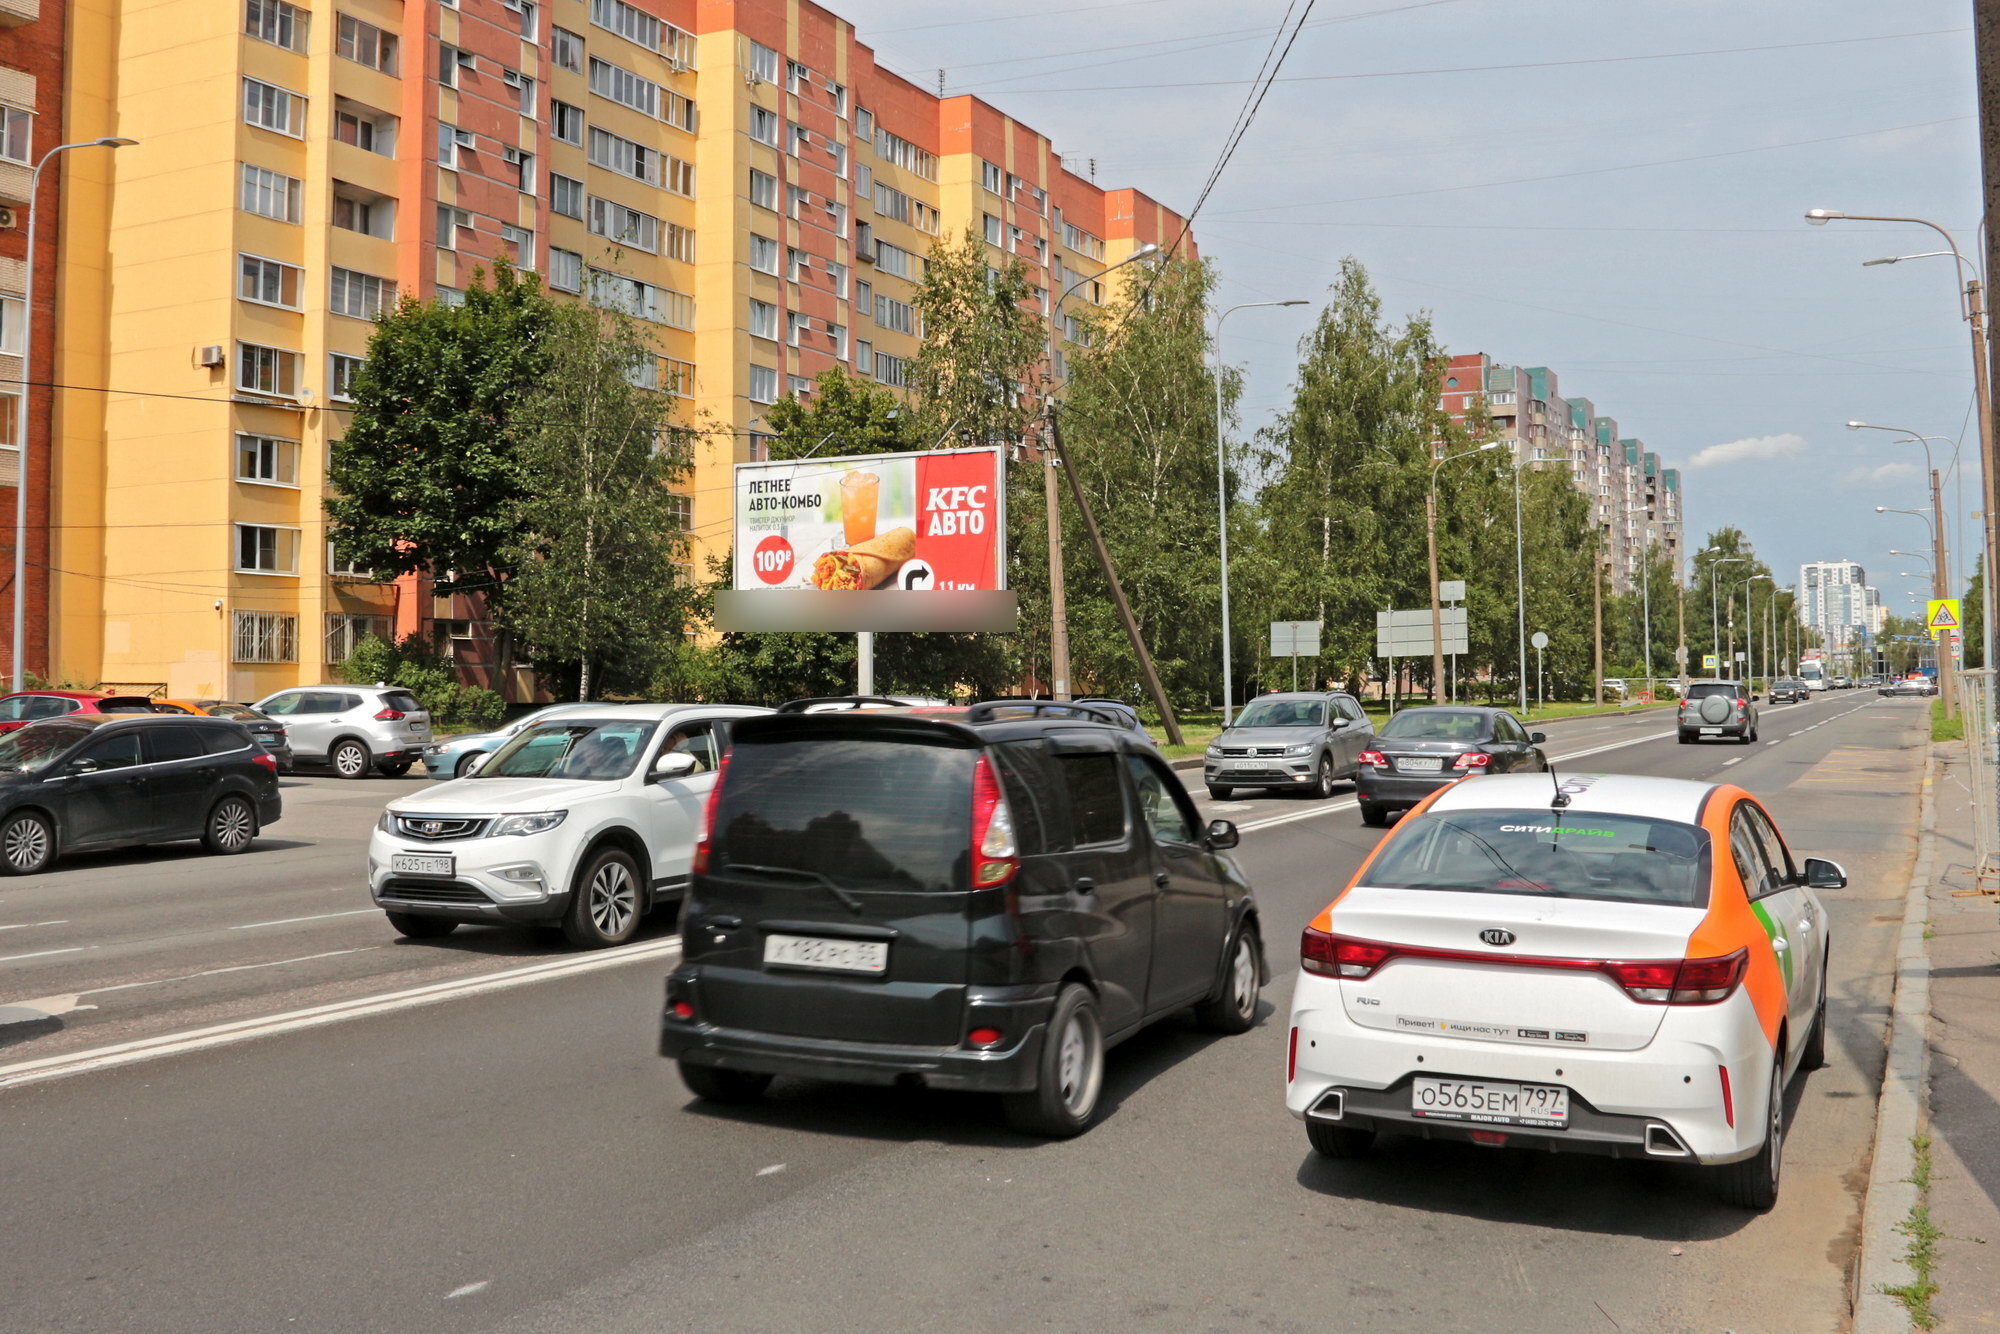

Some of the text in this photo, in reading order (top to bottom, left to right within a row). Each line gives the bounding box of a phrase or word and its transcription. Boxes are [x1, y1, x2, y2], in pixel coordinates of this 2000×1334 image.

[749, 479, 791, 494] ЛЕТНЕЕ
[749, 494, 822, 511] АВТО-КОМБО
[926, 485, 987, 511] KFC
[928, 510, 985, 536] АВТО
[1500, 825, 1616, 838] СИТИДРАЙВ
[395, 858, 449, 871] К625ТЕ 198
[1484, 931, 1510, 944] KIA
[1398, 1018, 1510, 1036] Привет! ищи нас тут
[1421, 1083, 1561, 1112] О565ЕМ 797
[1471, 1114, 1492, 1122] MAJOR
[1531, 1107, 1549, 1115] RUS
